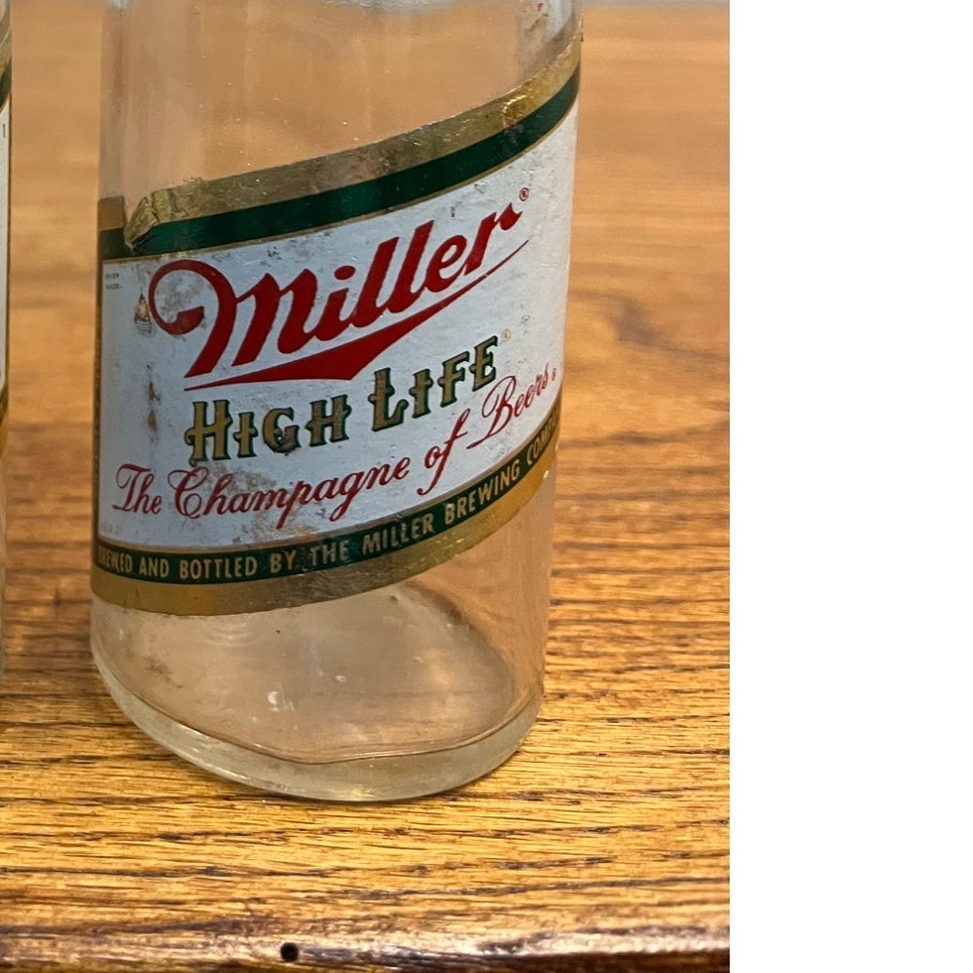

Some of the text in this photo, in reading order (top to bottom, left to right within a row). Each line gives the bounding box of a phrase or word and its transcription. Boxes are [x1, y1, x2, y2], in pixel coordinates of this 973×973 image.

[149, 203, 528, 391] Miller
[113, 364, 550, 529] The Champagne of Beers
[184, 335, 497, 467] HIGH LIFE
[139, 556, 169, 578] AND
[179, 555, 258, 580] BOTTLED
[270, 549, 297, 574] BY
[310, 536, 349, 566] THE
[362, 513, 434, 552] MILLER
[443, 458, 520, 525] BREWING
